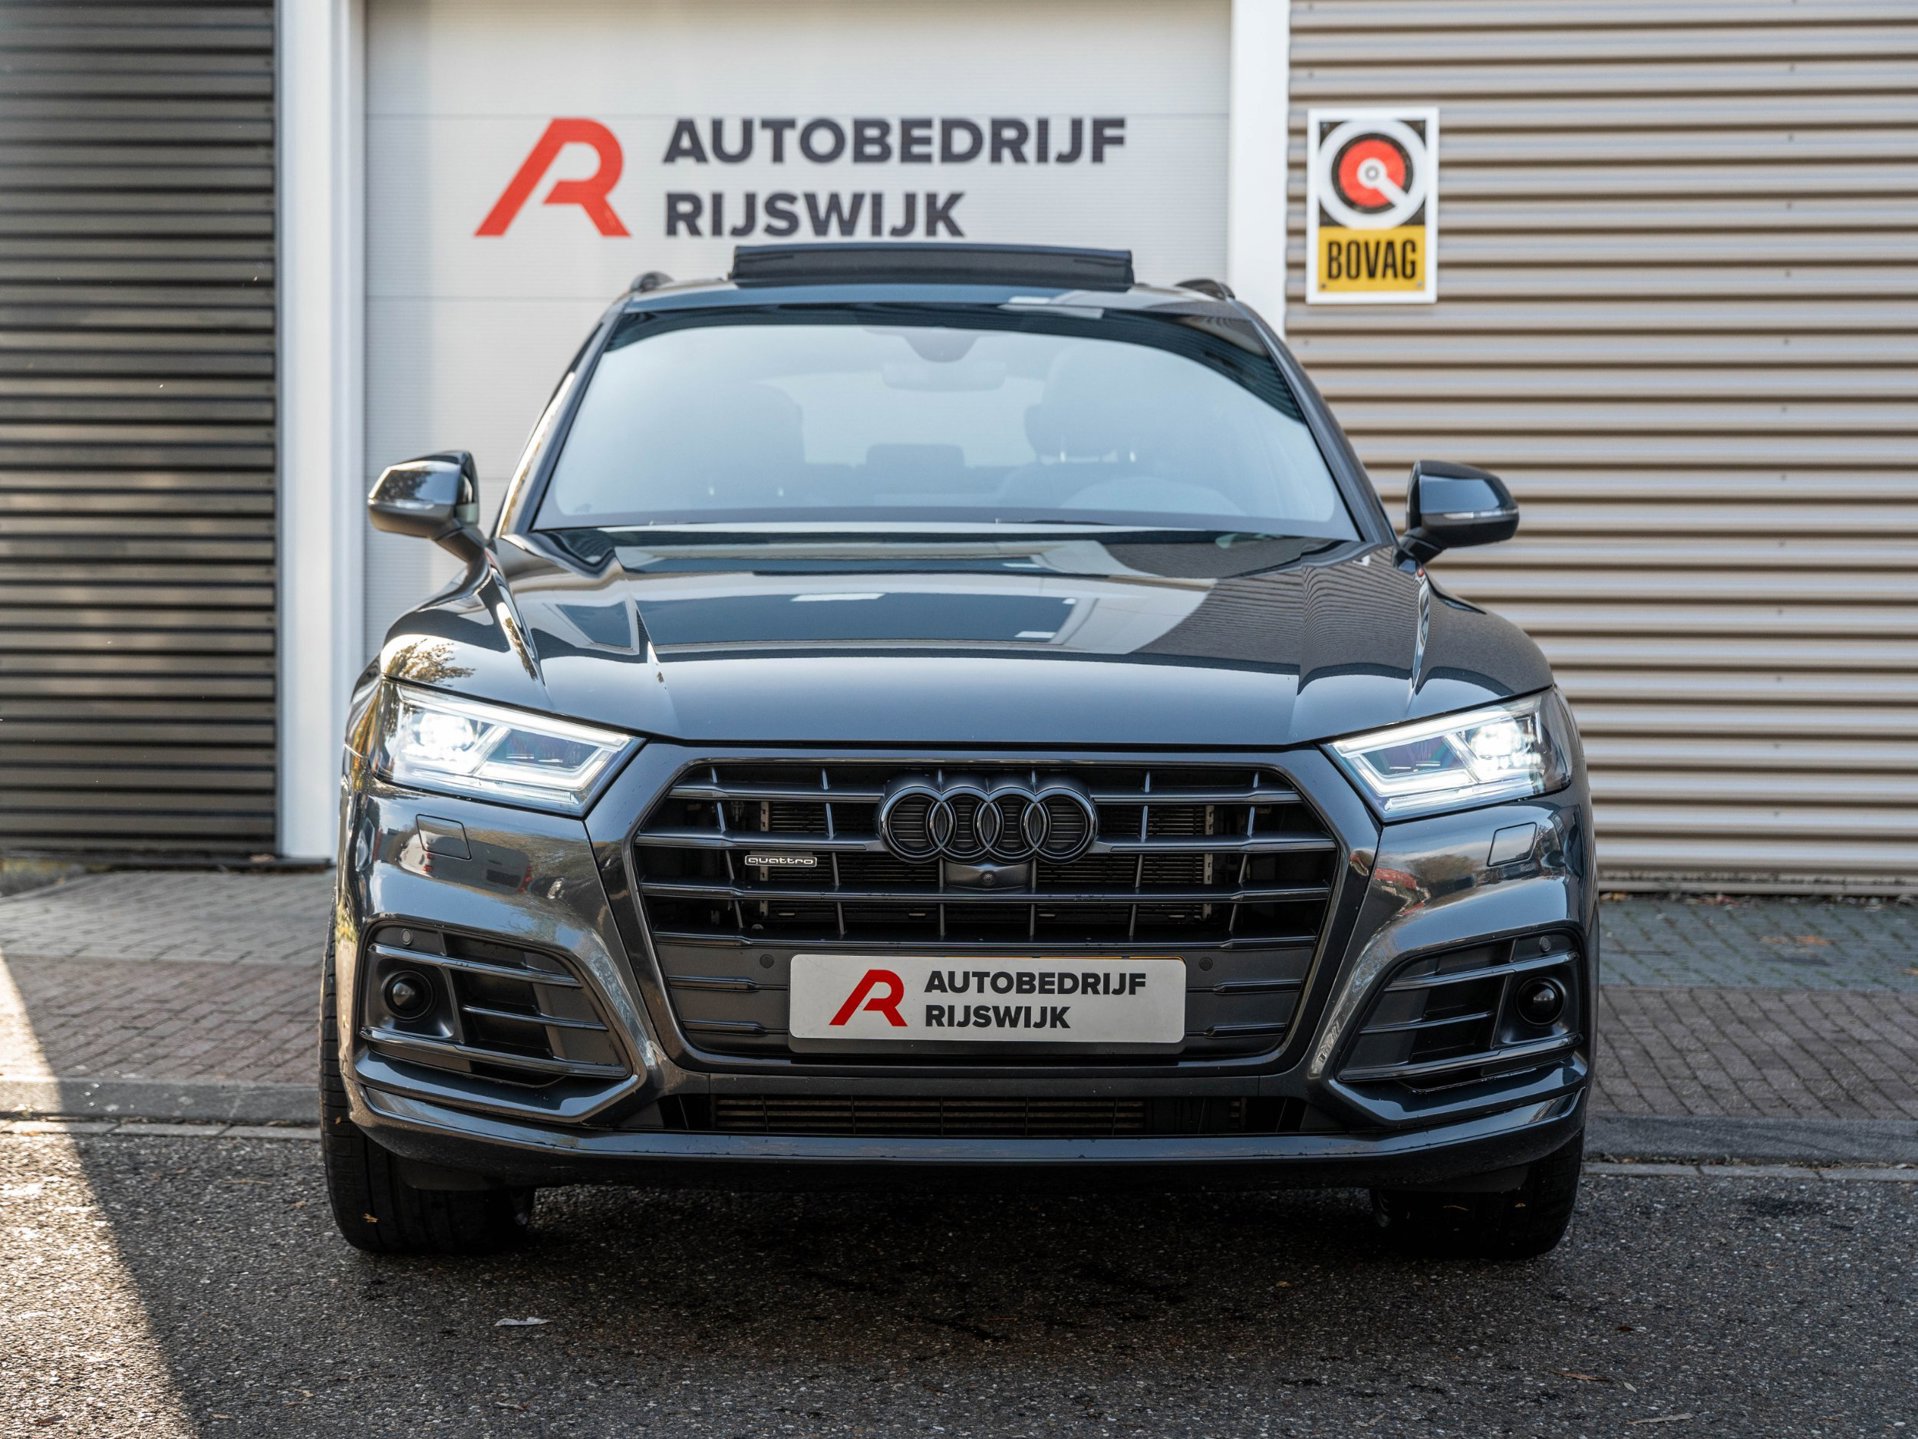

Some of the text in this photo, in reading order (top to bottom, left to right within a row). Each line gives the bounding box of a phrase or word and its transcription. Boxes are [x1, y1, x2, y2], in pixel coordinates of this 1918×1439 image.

[663, 118, 1127, 164] AUTOBEDRIJF
[665, 192, 966, 237] RIJSWIJK
[1327, 240, 1416, 280] BOVAG
[748, 857, 814, 865] quattro
[924, 970, 1146, 995] AUTOBEDRIJF
[925, 1005, 1071, 1029] RIJSWIJK
